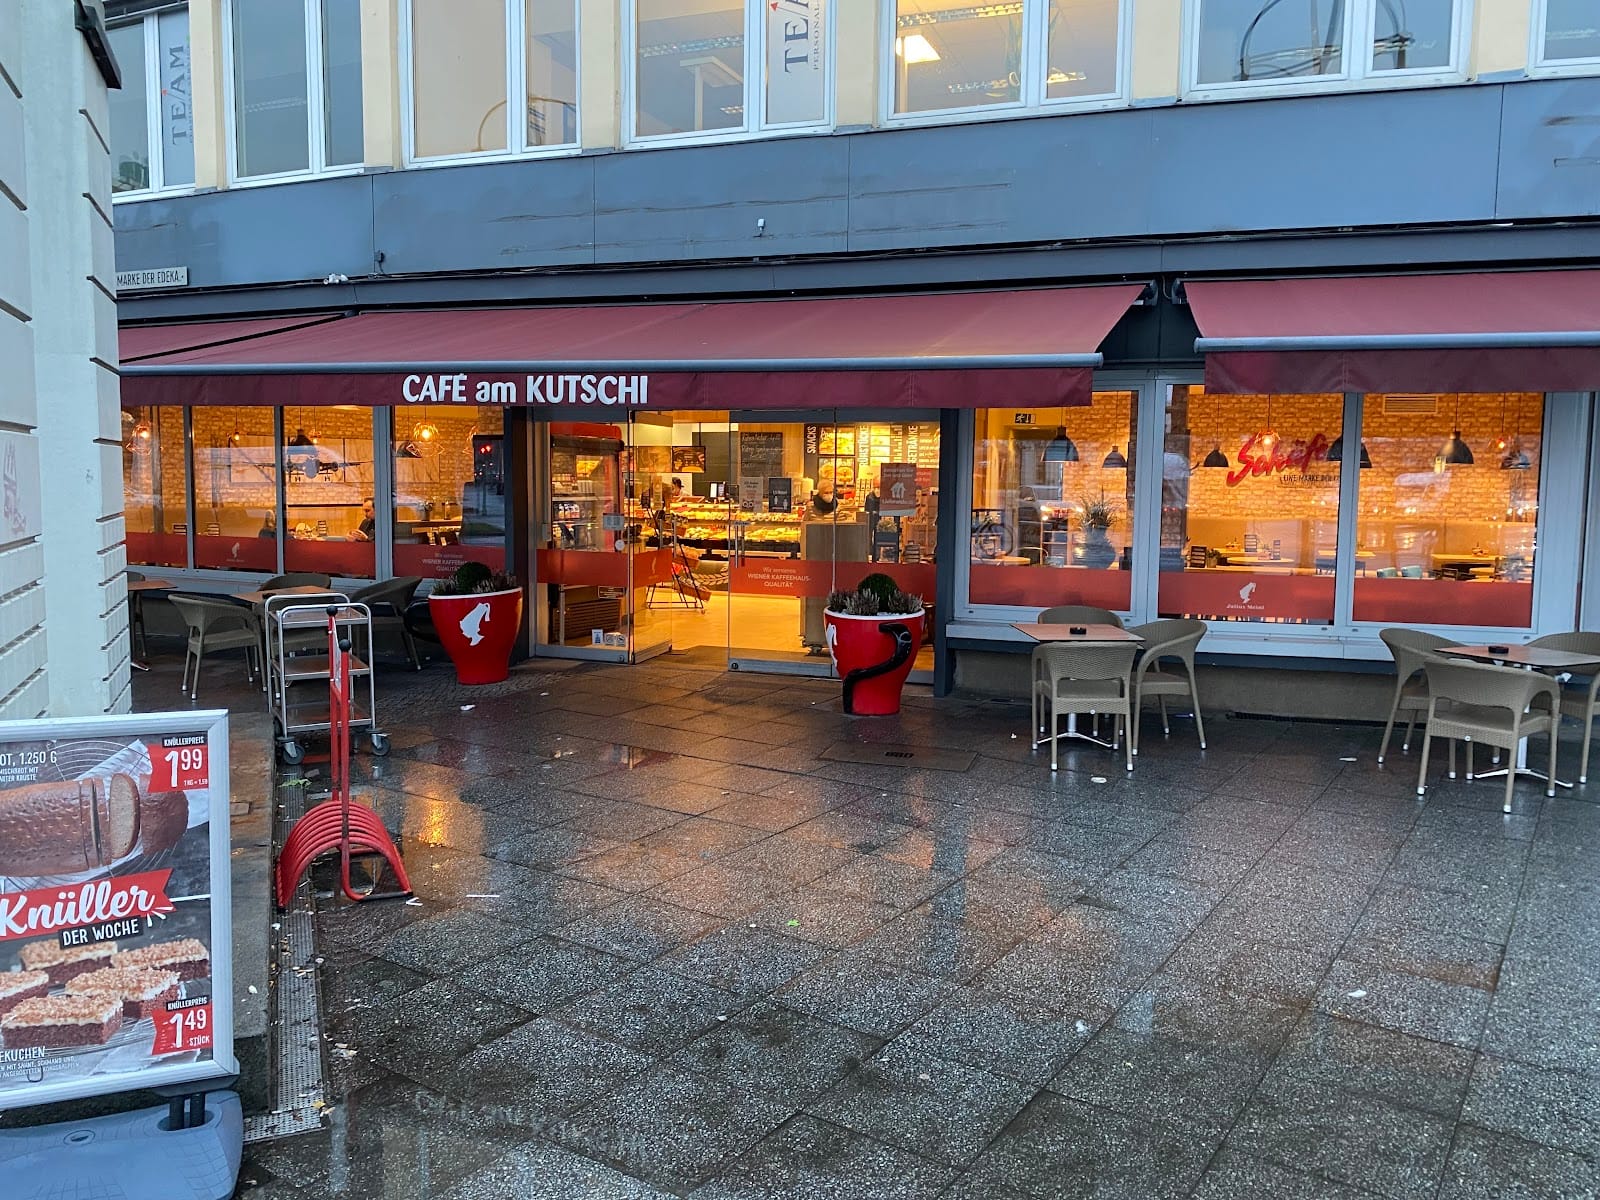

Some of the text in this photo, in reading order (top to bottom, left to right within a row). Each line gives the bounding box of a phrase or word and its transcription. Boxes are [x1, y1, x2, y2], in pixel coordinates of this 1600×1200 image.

[168, 46, 187, 145] TEAM
[116, 270, 179, 286] MARKE DER EDEKA
[402, 373, 648, 405] CAFÉ am KUTSCHI
[806, 425, 817, 454] SNACKS
[764, 580, 794, 588] QUALITÄT
[164, 736, 204, 746] KNÜLLERPREIS
[19, 751, 46, 765] 1.250
[50, 750, 57, 764] G
[0, 880, 156, 937] Knüller
[62, 918, 139, 946] DER WOCHE
[167, 996, 208, 1011] KNÜLLERPREIS
[189, 1034, 210, 1046] STÜCK
